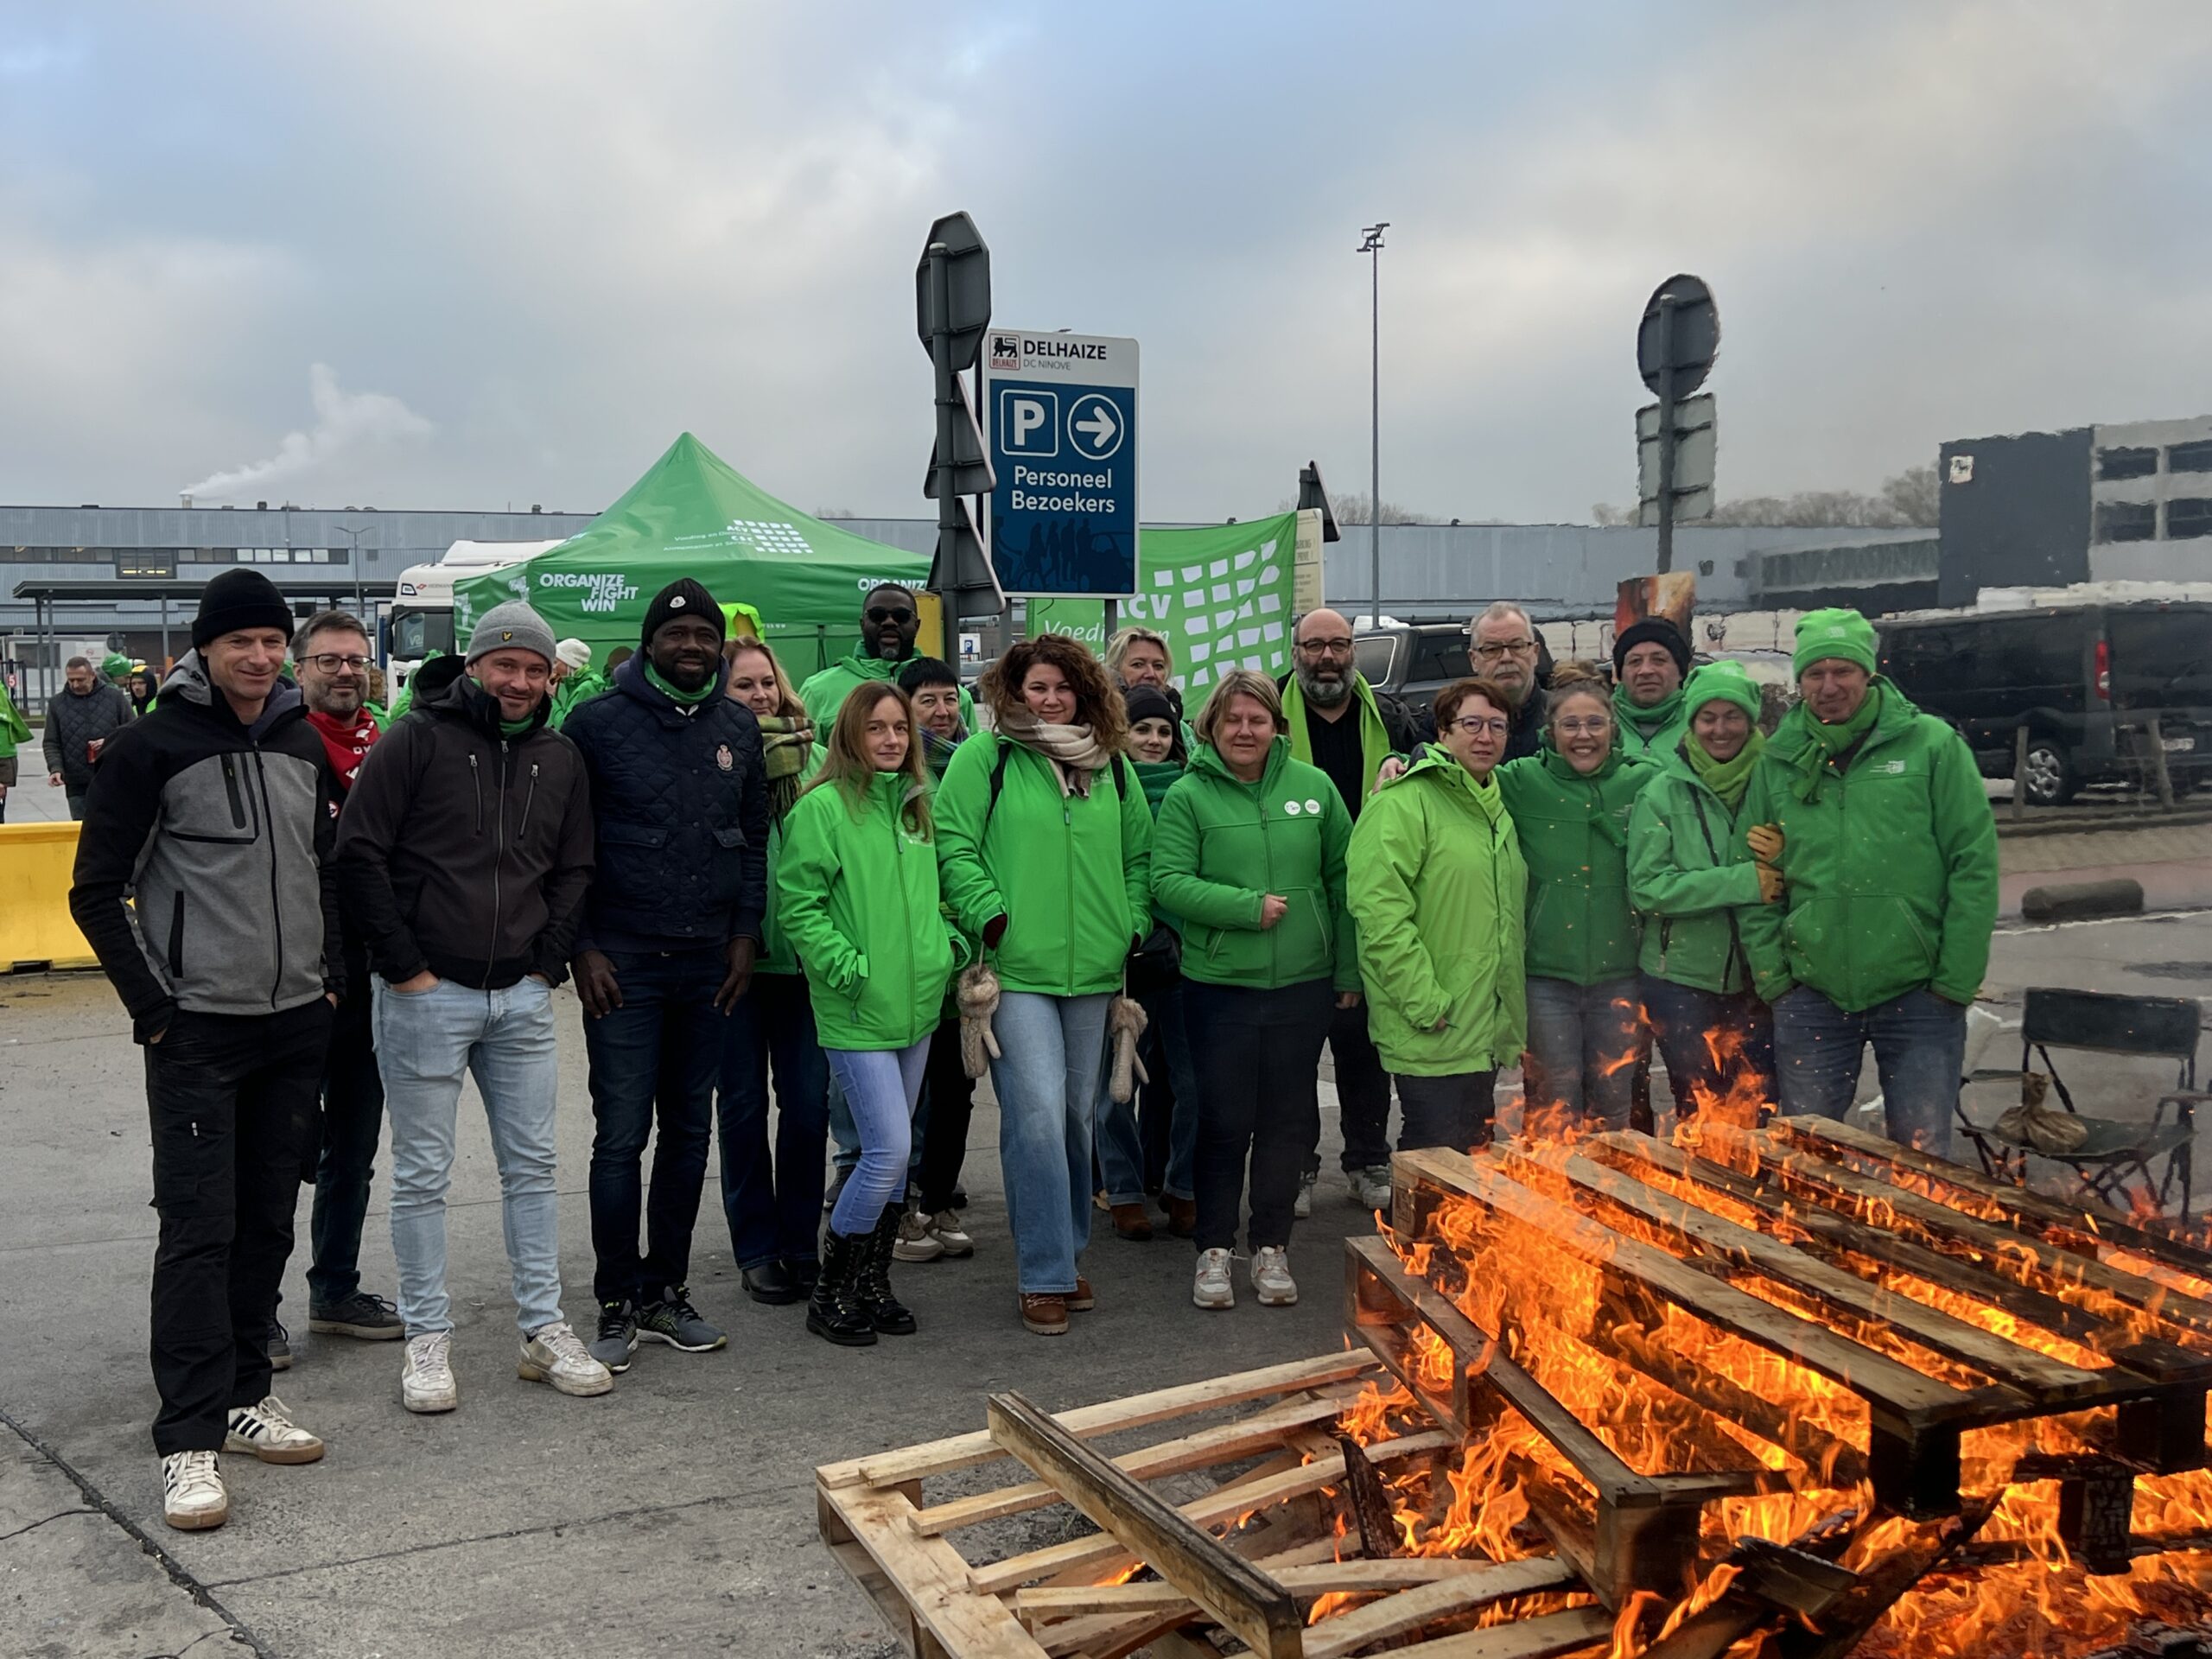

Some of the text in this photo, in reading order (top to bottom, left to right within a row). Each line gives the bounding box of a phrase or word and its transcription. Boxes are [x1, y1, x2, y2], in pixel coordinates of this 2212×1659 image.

[1023, 340, 1107, 360] DELHAIZE
[992, 358, 1017, 368] DELHAIZE
[1023, 359, 1071, 371] DC NINOVE
[1014, 399, 1046, 446] P
[1014, 465, 1112, 489] Personeel
[1012, 490, 1116, 513] Bezoekers
[539, 573, 626, 588] ORGANIZE
[590, 586, 639, 600] FIGHT
[581, 598, 615, 612] WIN
